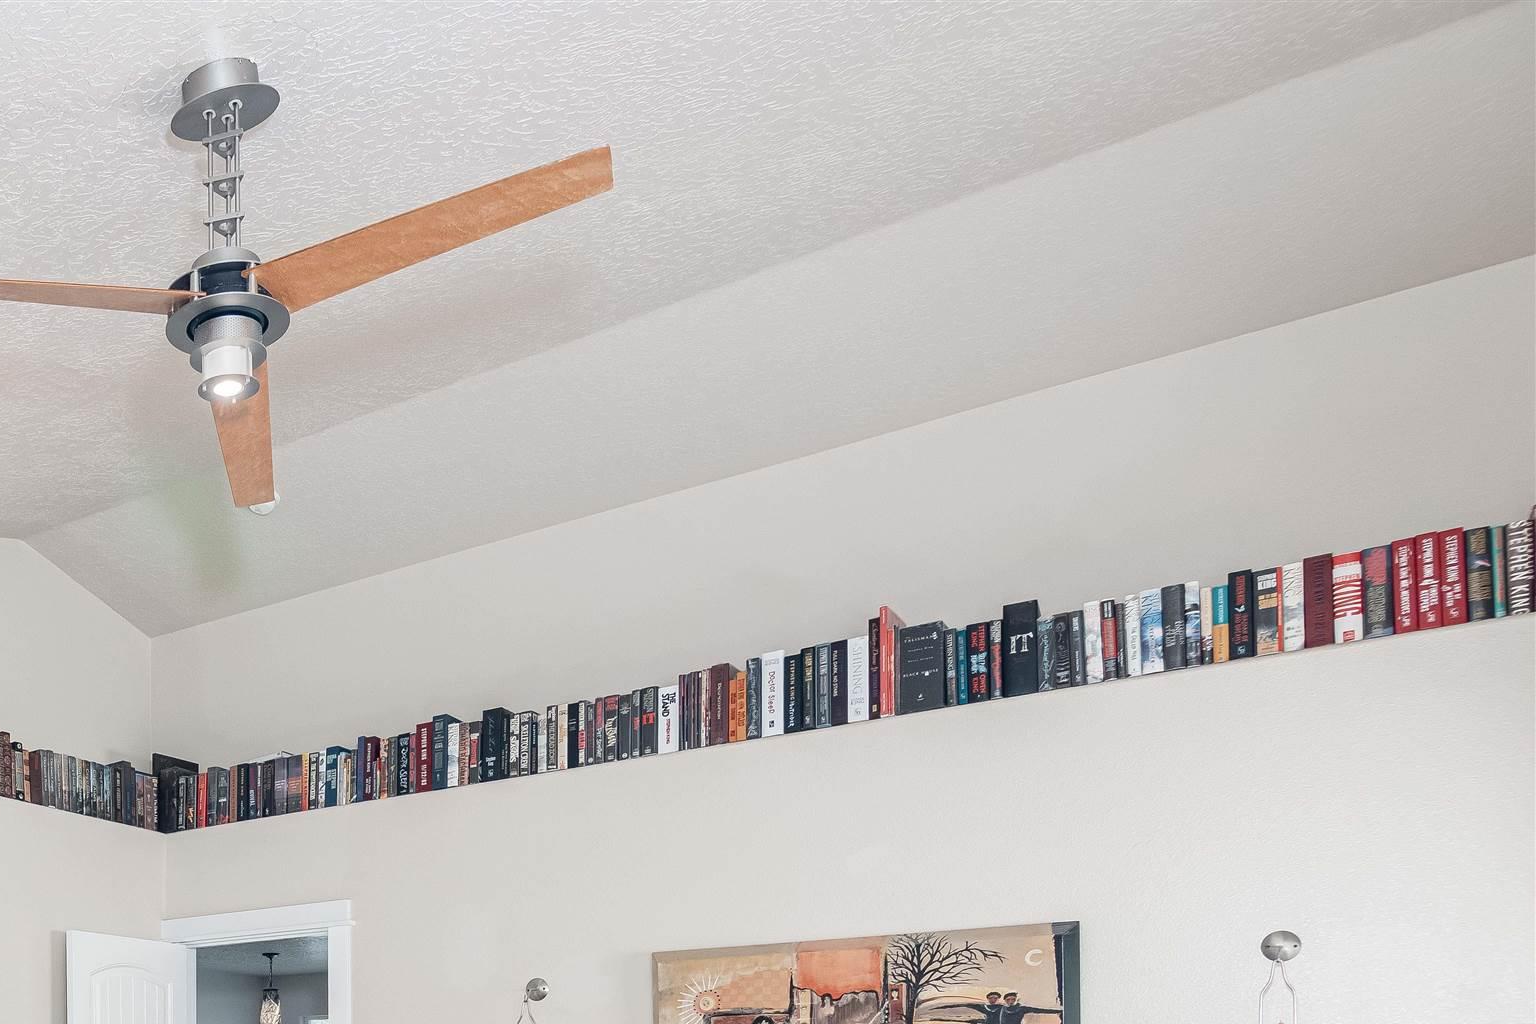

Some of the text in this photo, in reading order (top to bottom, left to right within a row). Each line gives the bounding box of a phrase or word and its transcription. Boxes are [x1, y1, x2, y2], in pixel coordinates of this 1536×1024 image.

[1399, 547, 1408, 567] STEPHEN
[1422, 539, 1434, 578] STEPHEN KING
[1446, 535, 1459, 582] STEPHEN KING
[1508, 520, 1529, 581] STEPHEN
[1400, 567, 1409, 579] KING
[1009, 631, 1034, 655] IT
[853, 647, 864, 695] SHINING
[971, 677, 979, 693] KING
[979, 675, 987, 693] OWEN
[520, 725, 528, 769] SKELETON CREW
